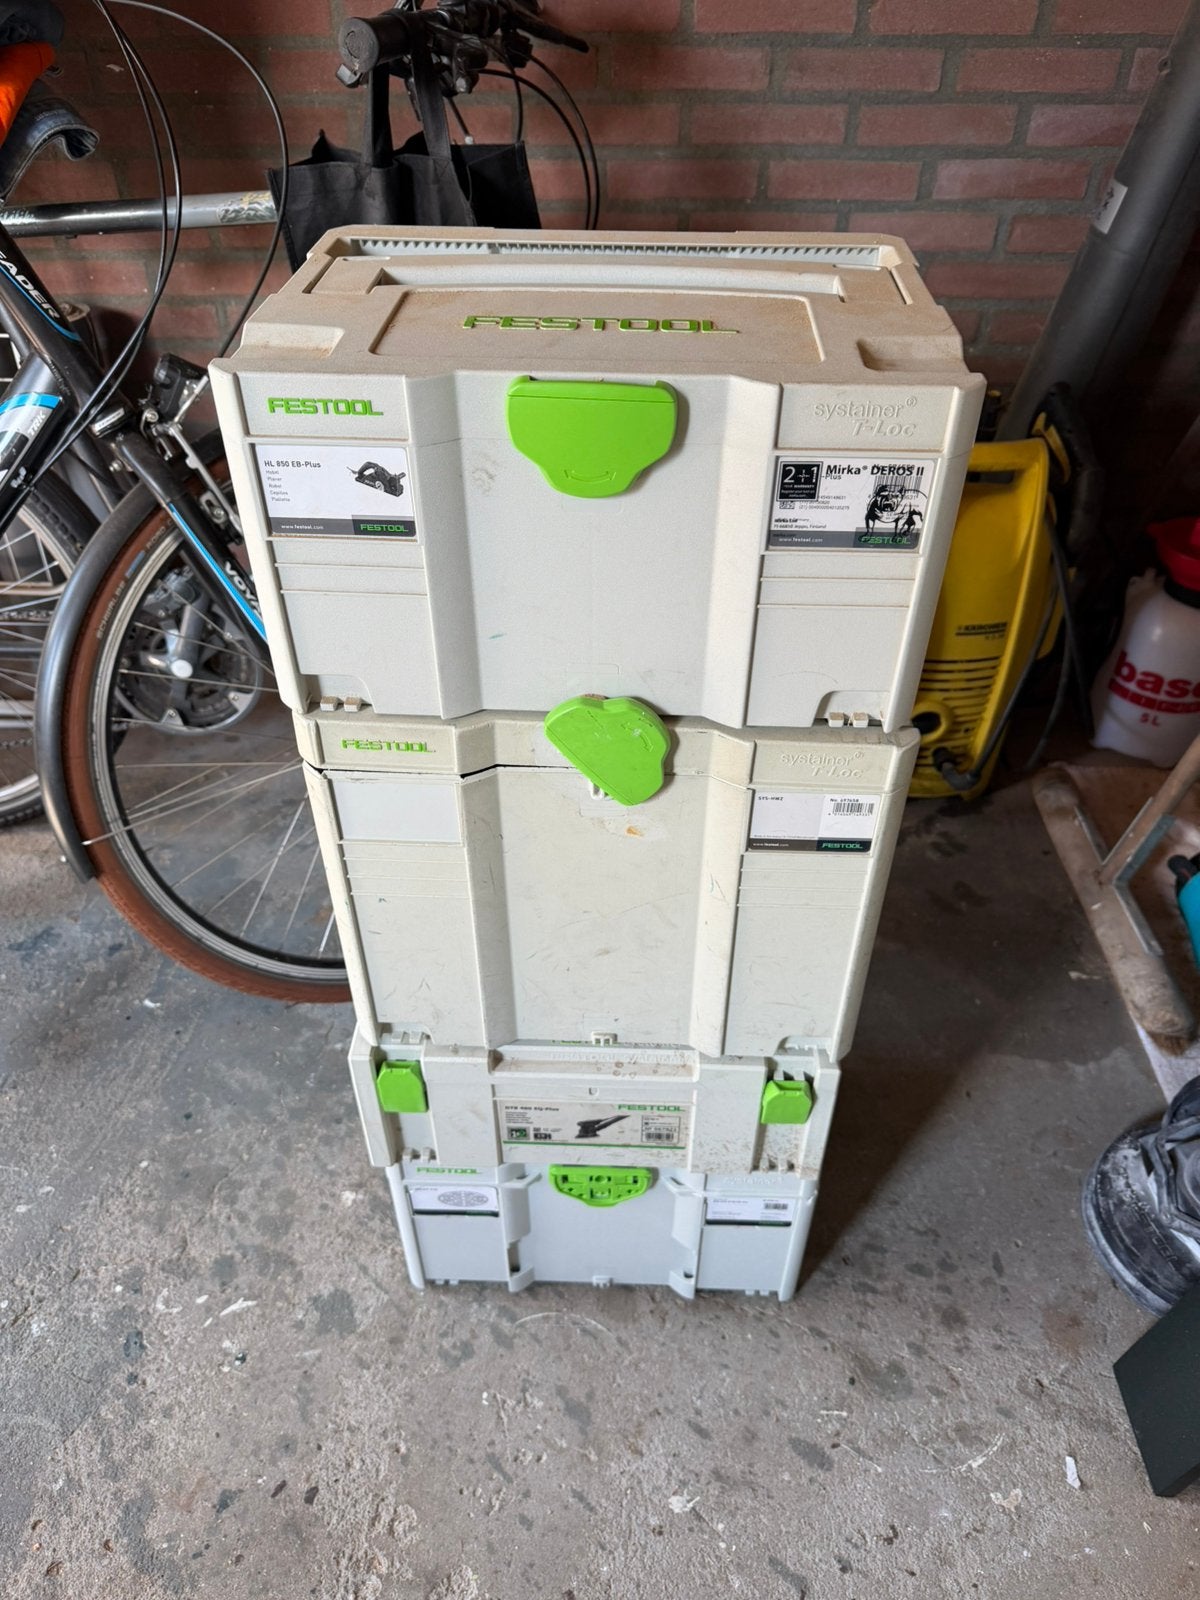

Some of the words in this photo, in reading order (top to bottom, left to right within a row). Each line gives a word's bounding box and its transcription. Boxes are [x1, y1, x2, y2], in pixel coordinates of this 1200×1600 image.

[462, 315, 740, 333] FESTOOL
[267, 397, 384, 416] FESTOOL
[870, 465, 913, 476] DEROS
[916, 466, 925, 476] II
[360, 523, 409, 532] FESTOOL
[341, 739, 436, 753] FESTOOL
[618, 1104, 686, 1112] FESTOOL
[416, 1166, 483, 1175] FESTOOL
